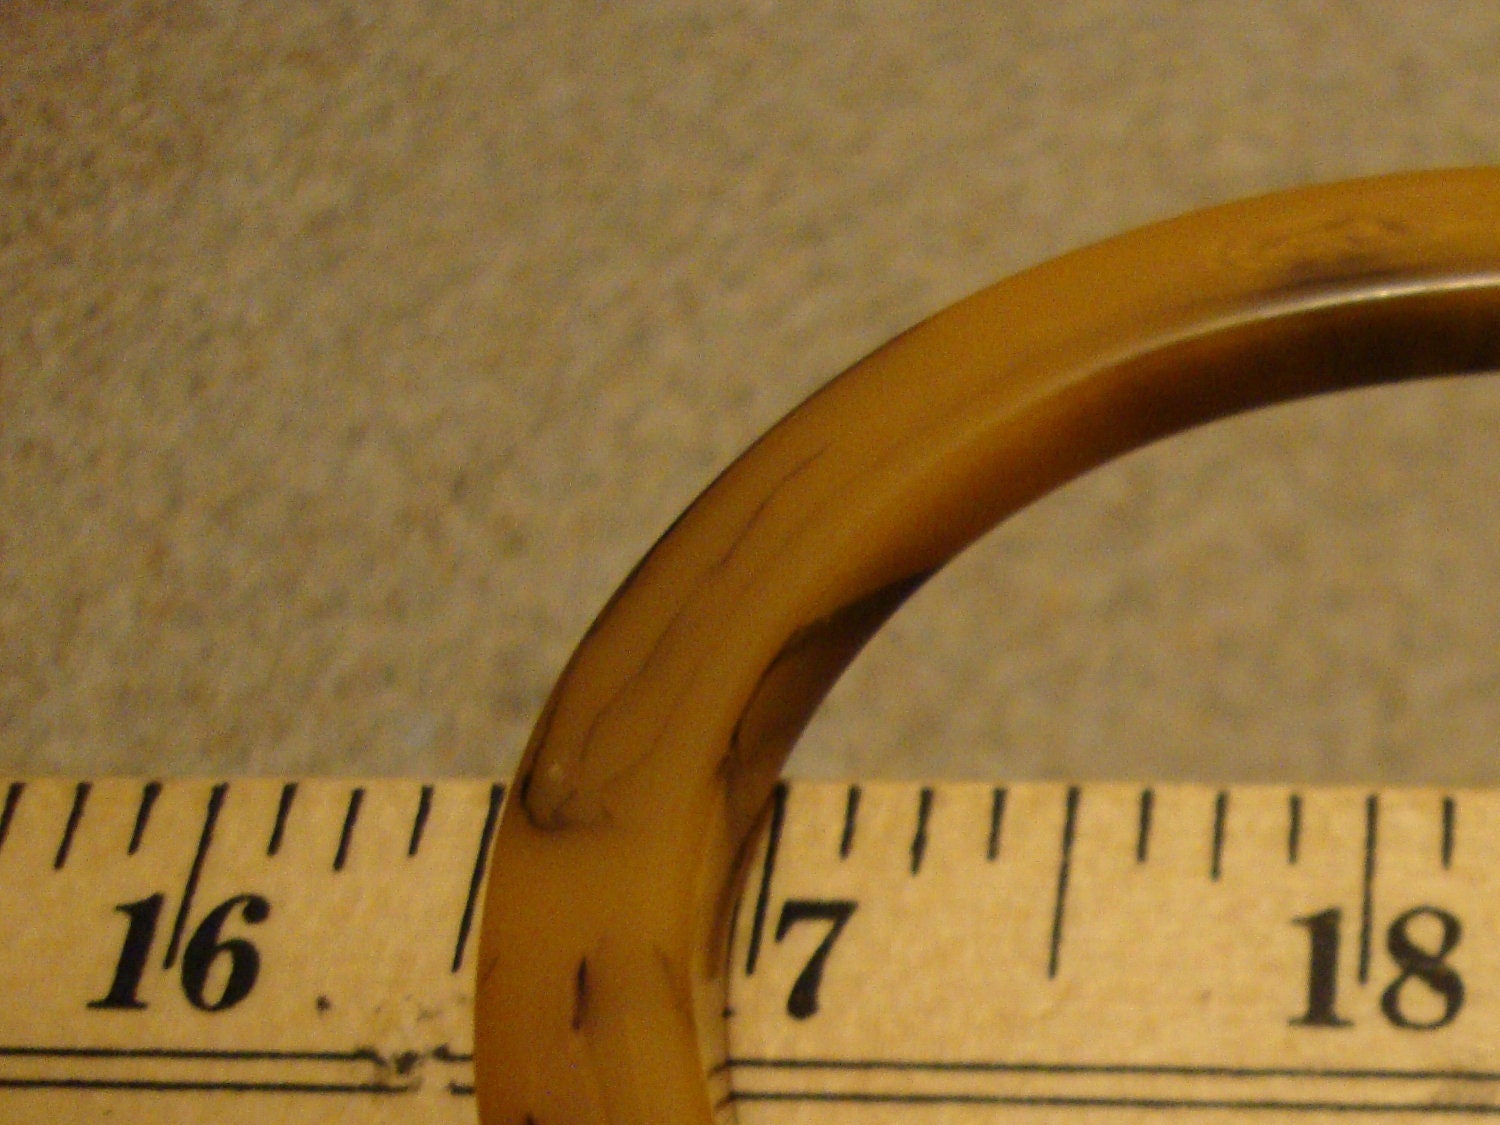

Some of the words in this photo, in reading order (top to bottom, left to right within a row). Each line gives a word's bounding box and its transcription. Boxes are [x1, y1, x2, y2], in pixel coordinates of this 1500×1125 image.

[85, 892, 271, 1014] 16
[773, 899, 859, 1021] 7
[1289, 906, 1466, 1031] 18
